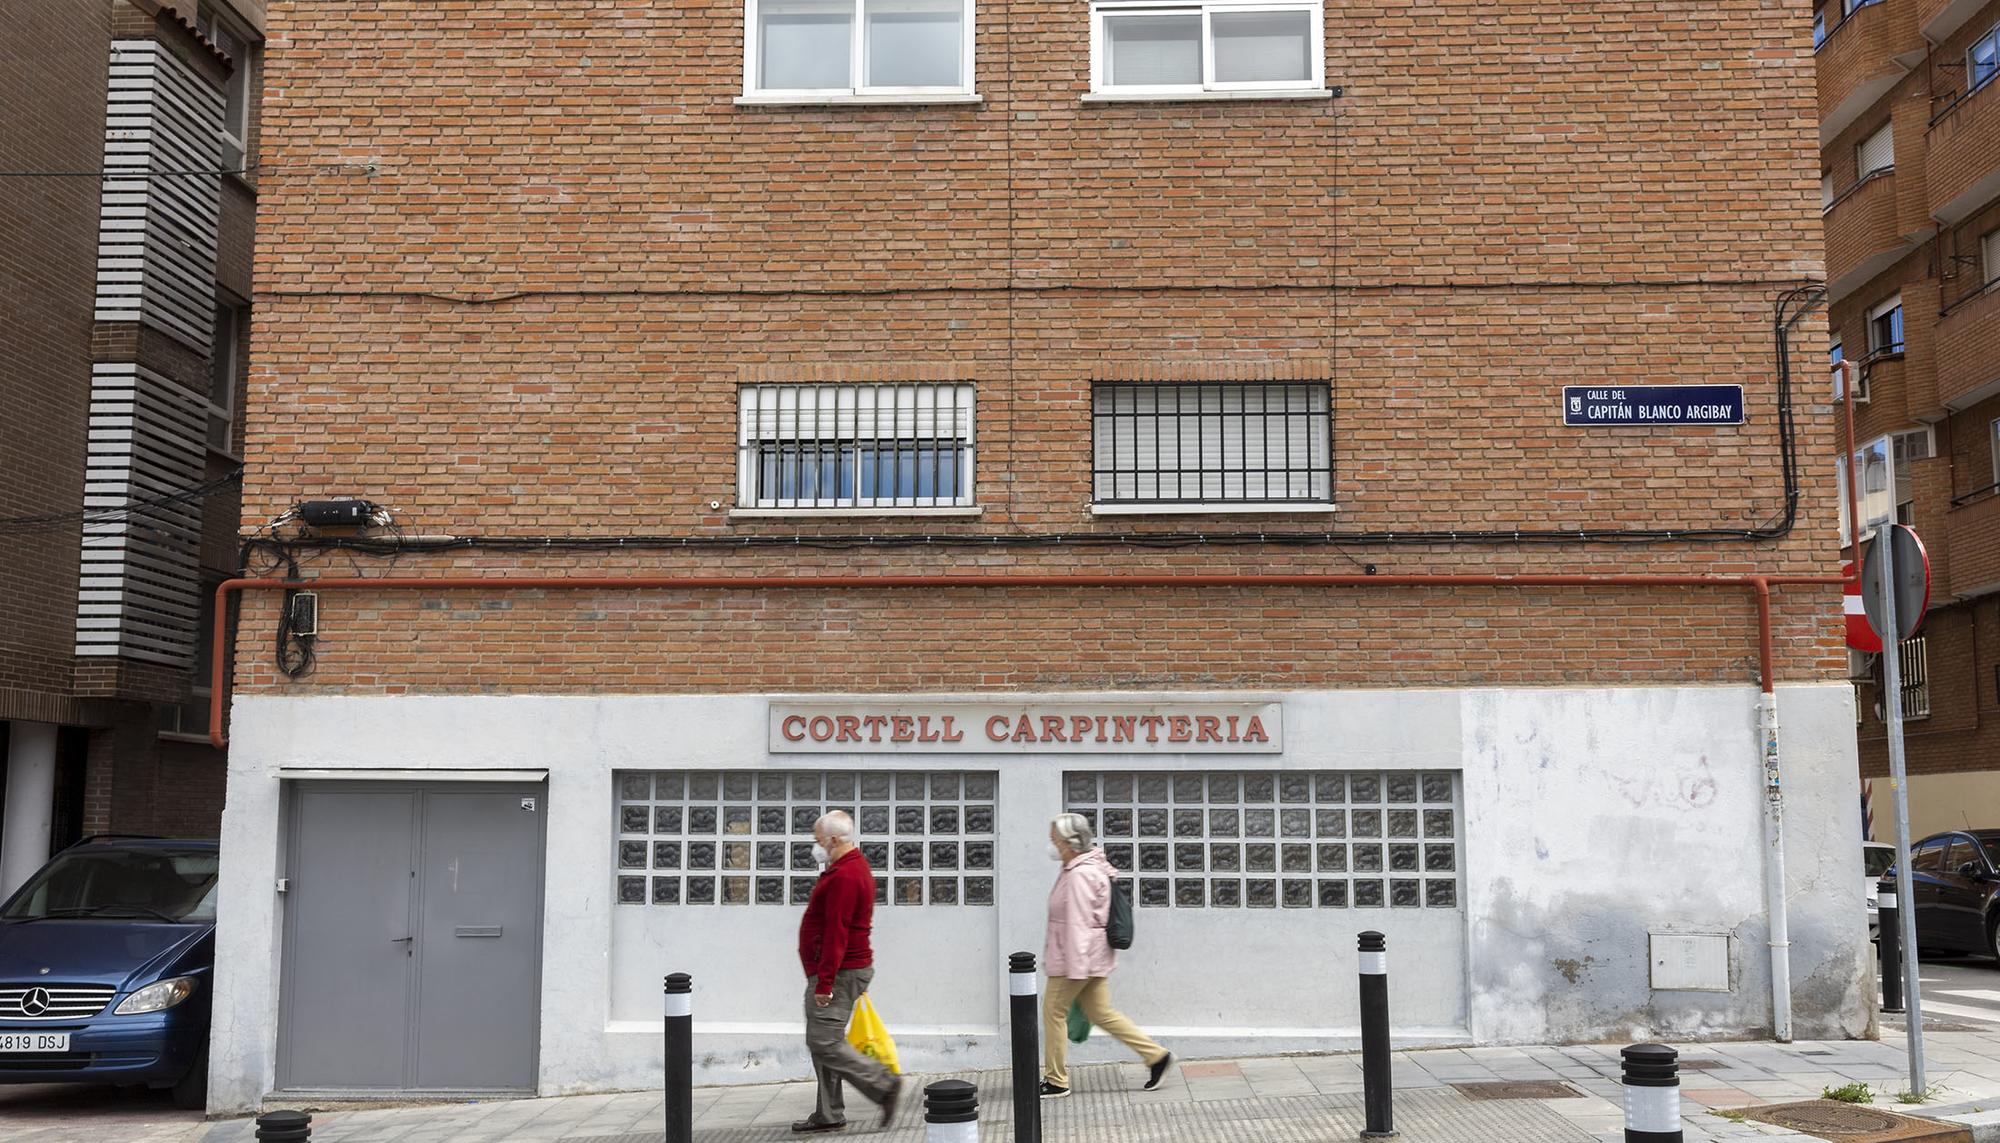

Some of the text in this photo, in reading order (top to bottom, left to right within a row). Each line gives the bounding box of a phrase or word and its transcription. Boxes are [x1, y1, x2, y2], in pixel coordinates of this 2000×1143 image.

[1587, 390, 1627, 400] CALLE DEL
[1587, 402, 1732, 419] CAPITÁN BLANCO ARGIBAY
[782, 714, 1269, 742] CORTELL CARPINTERIA
[38, 1035, 65, 1049] DSJ
